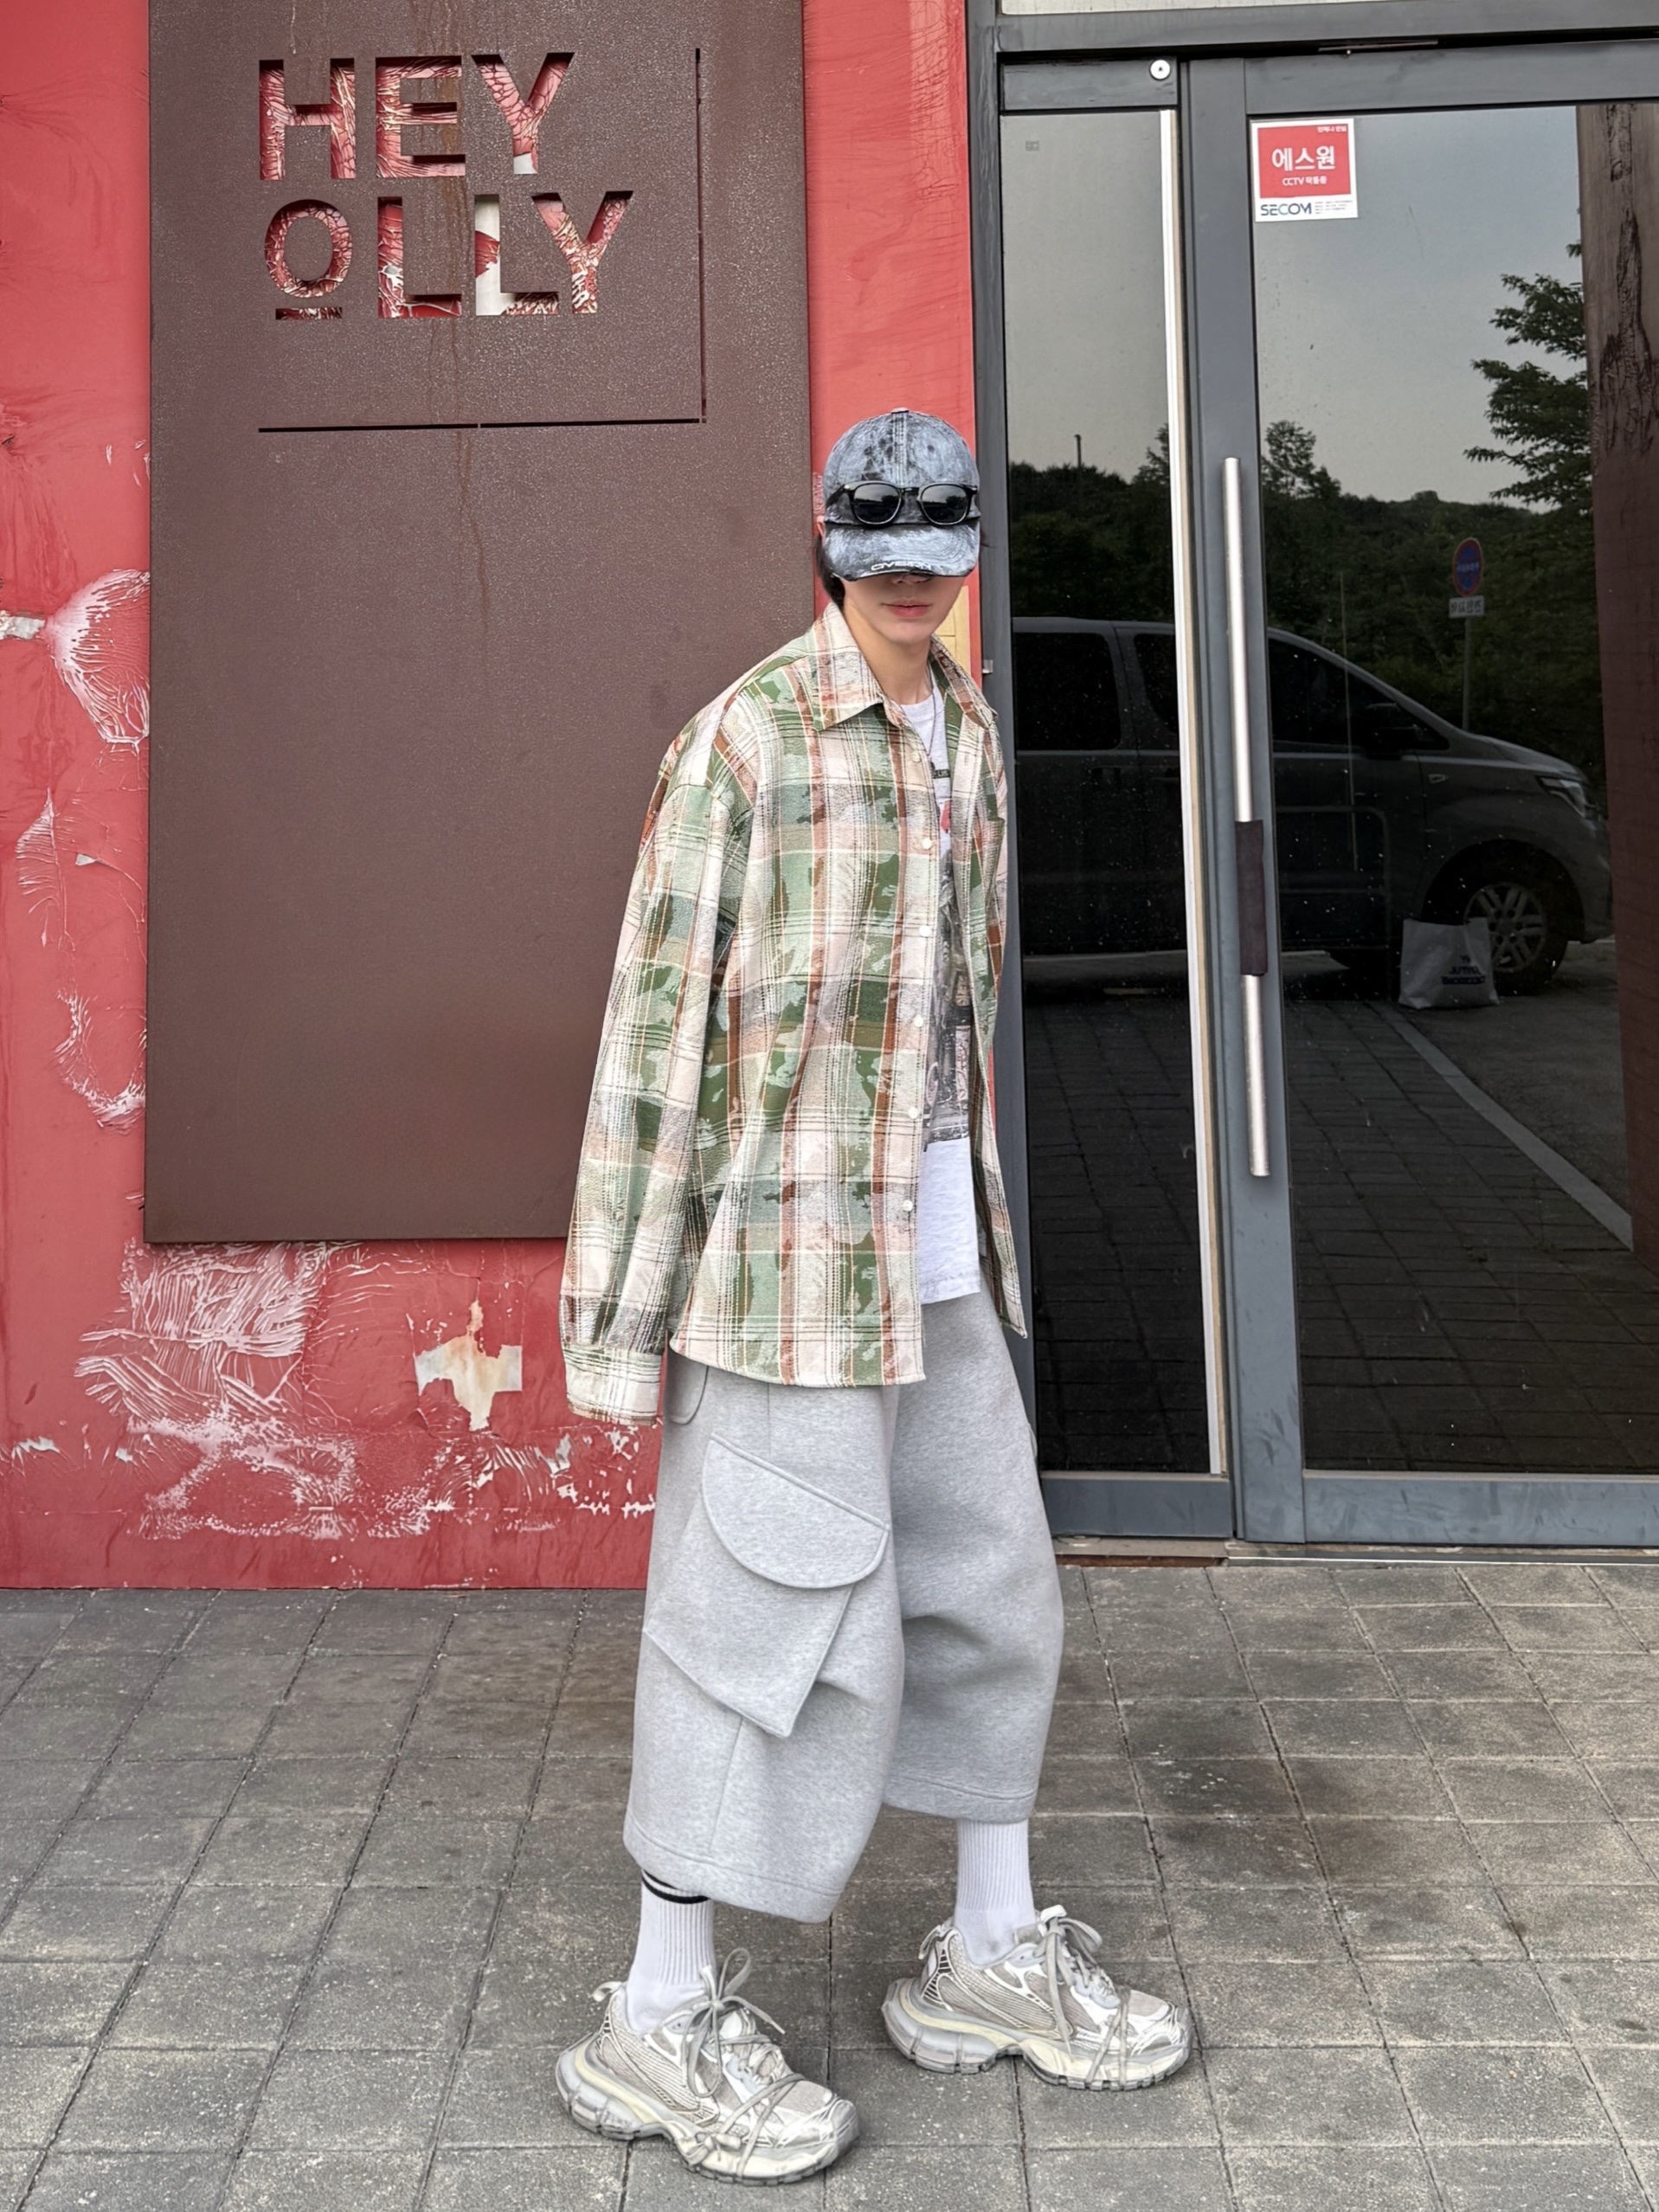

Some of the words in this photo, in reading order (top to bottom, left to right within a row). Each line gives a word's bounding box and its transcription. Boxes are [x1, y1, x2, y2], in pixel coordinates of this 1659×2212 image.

[259, 52, 575, 180] HEY
[1271, 145, 1335, 171] 에스원
[1282, 177, 1304, 186] CCTV
[1261, 203, 1312, 215] SECOM
[265, 190, 633, 319] OLLY
